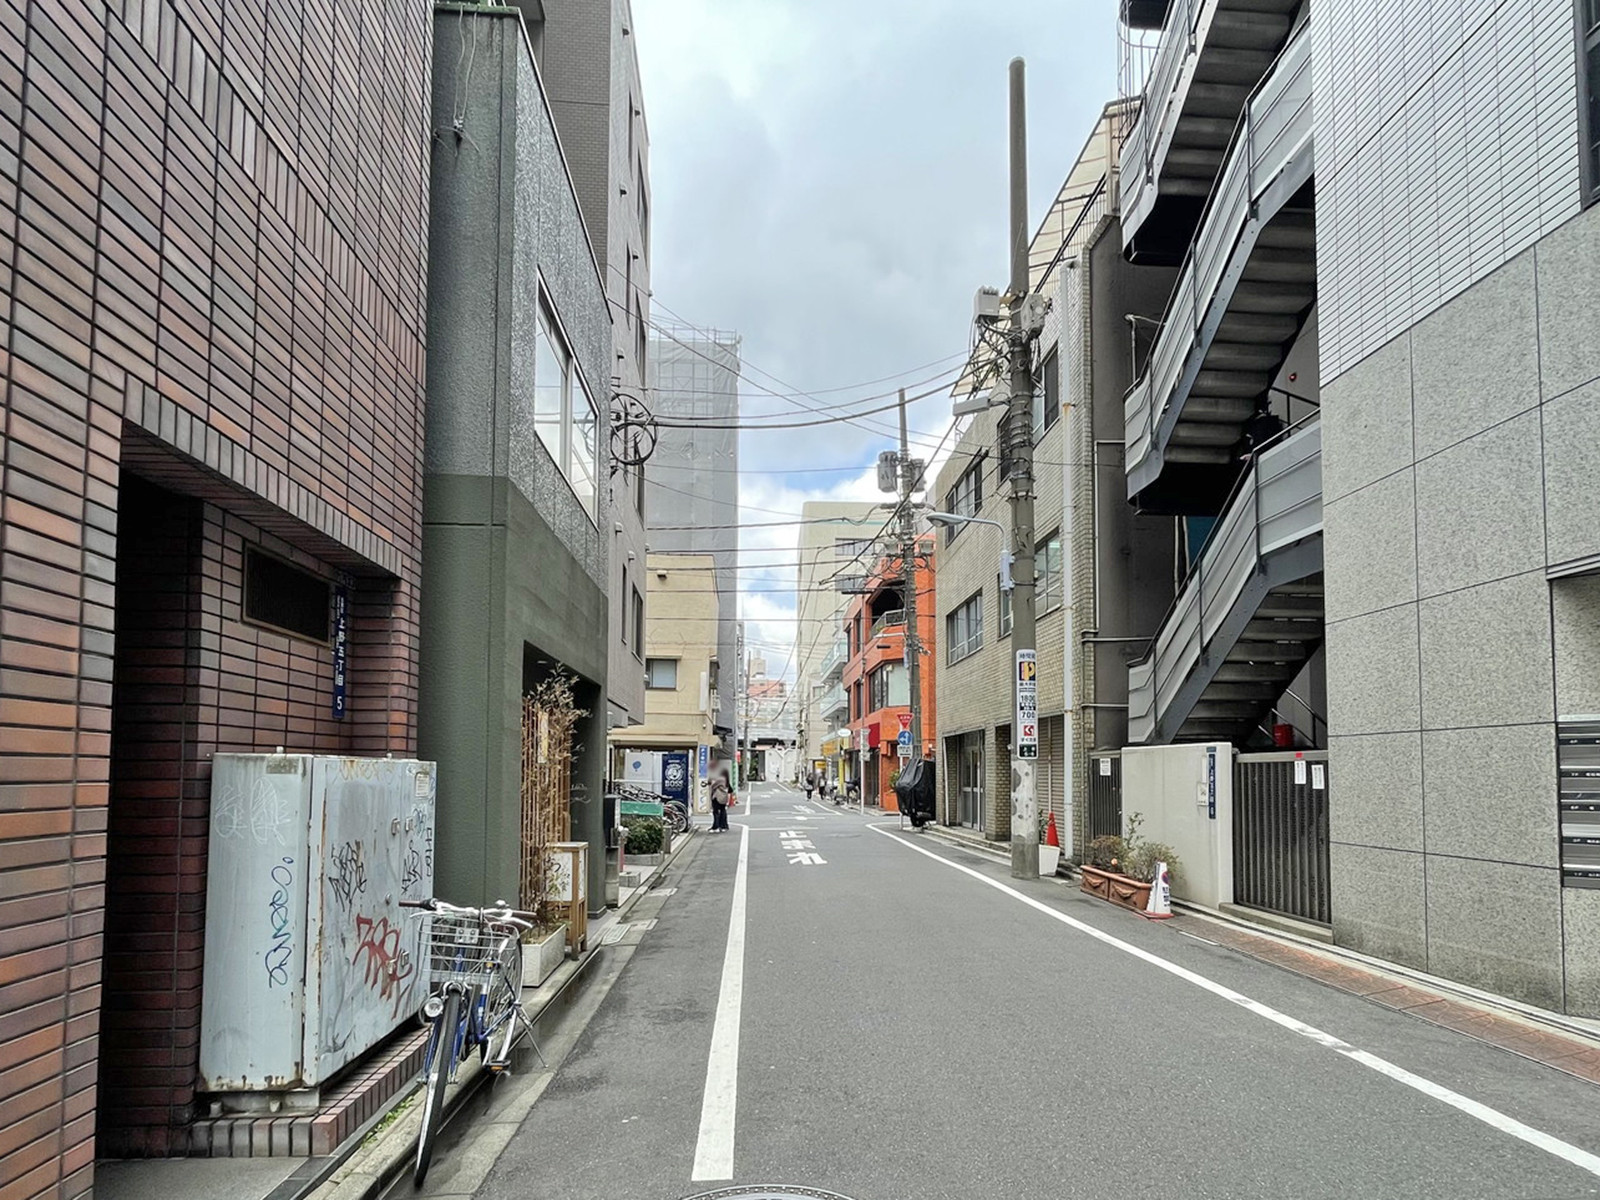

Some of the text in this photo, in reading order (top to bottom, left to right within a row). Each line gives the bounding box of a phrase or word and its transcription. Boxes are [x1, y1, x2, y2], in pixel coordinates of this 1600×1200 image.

[338, 617, 346, 686] 上野五丁目
[337, 695, 343, 711] 5
